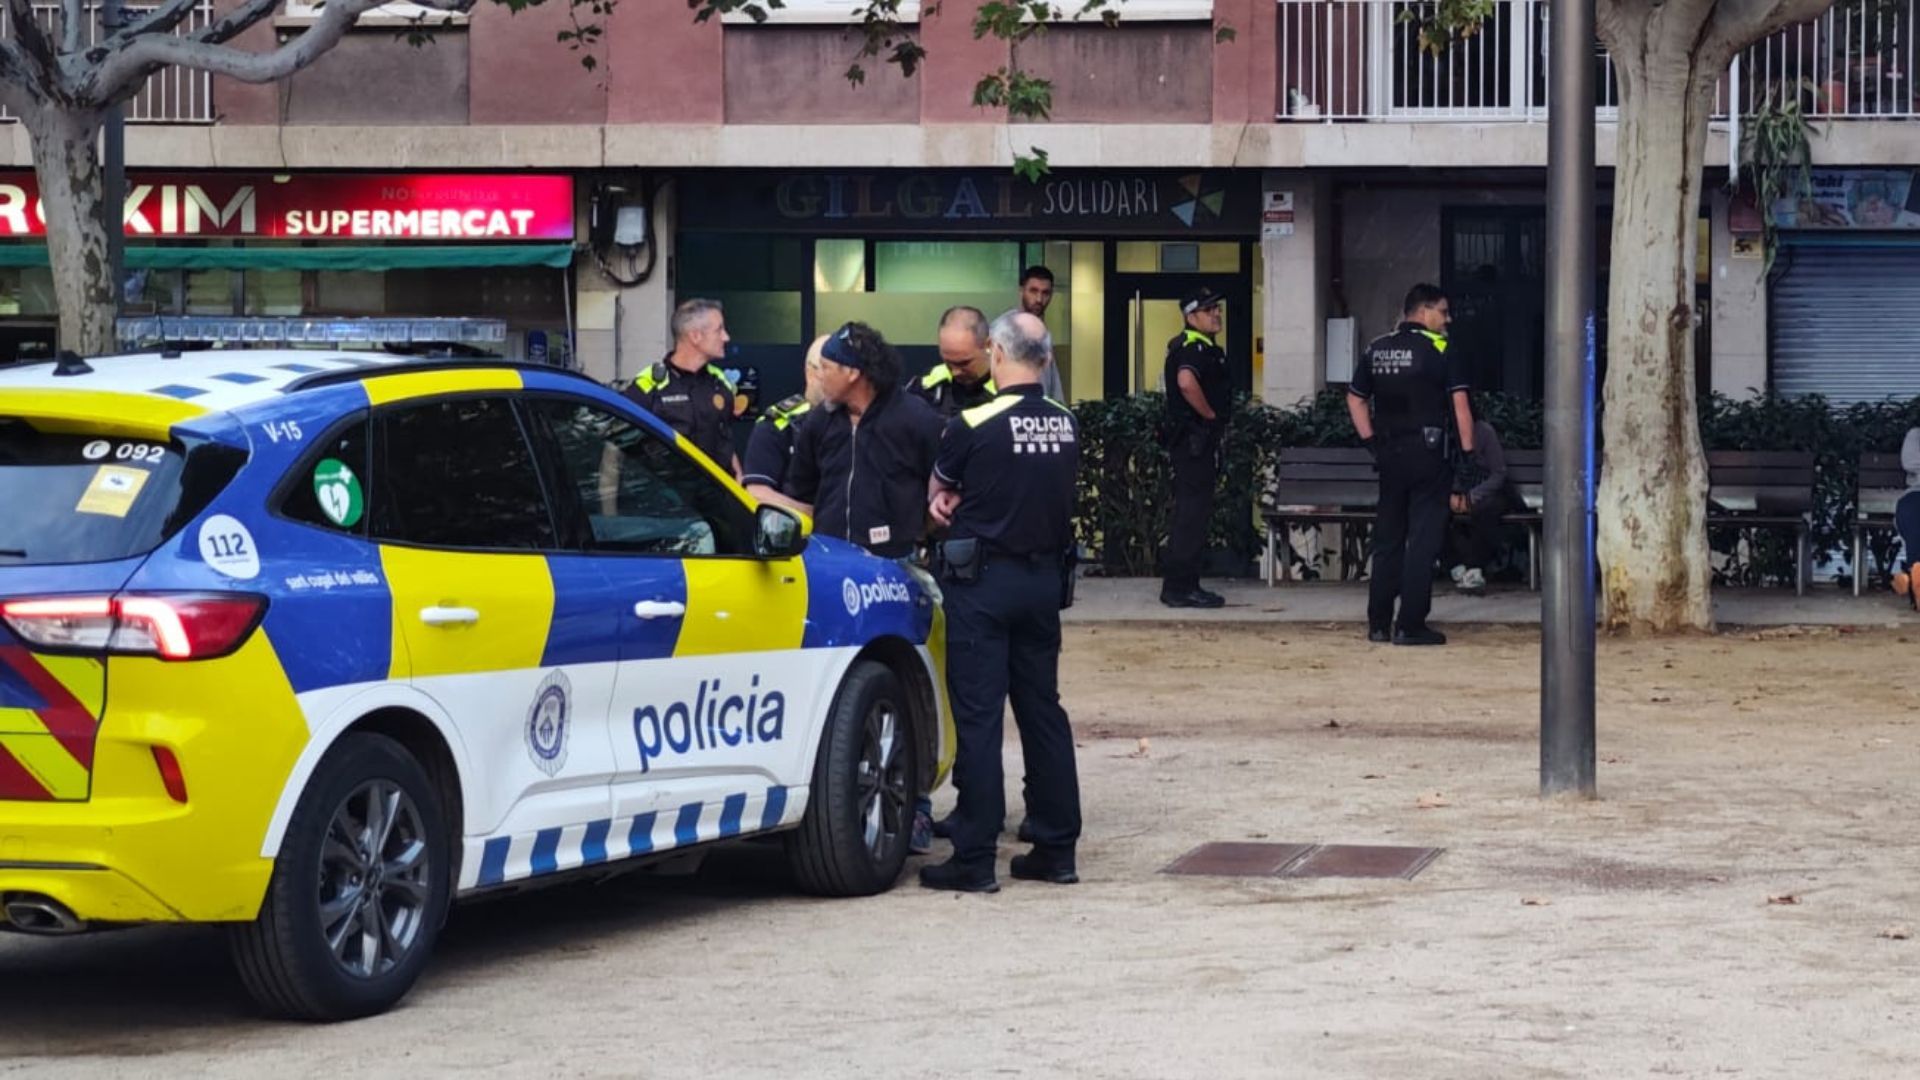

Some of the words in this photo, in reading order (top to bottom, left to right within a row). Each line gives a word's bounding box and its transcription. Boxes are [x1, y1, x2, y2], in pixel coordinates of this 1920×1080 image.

[776, 174, 1033, 219] GILGAL
[1042, 178, 1159, 216] SOLIDARI
[285, 209, 535, 236] SUPERMERCAT
[1371, 350, 1413, 361] POLICIA
[261, 420, 303, 443] V-15
[1008, 415, 1074, 433] POLICIA
[115, 442, 165, 464] 092
[207, 533, 249, 557] 112
[860, 575, 911, 610] policia
[632, 673, 786, 774] policia
